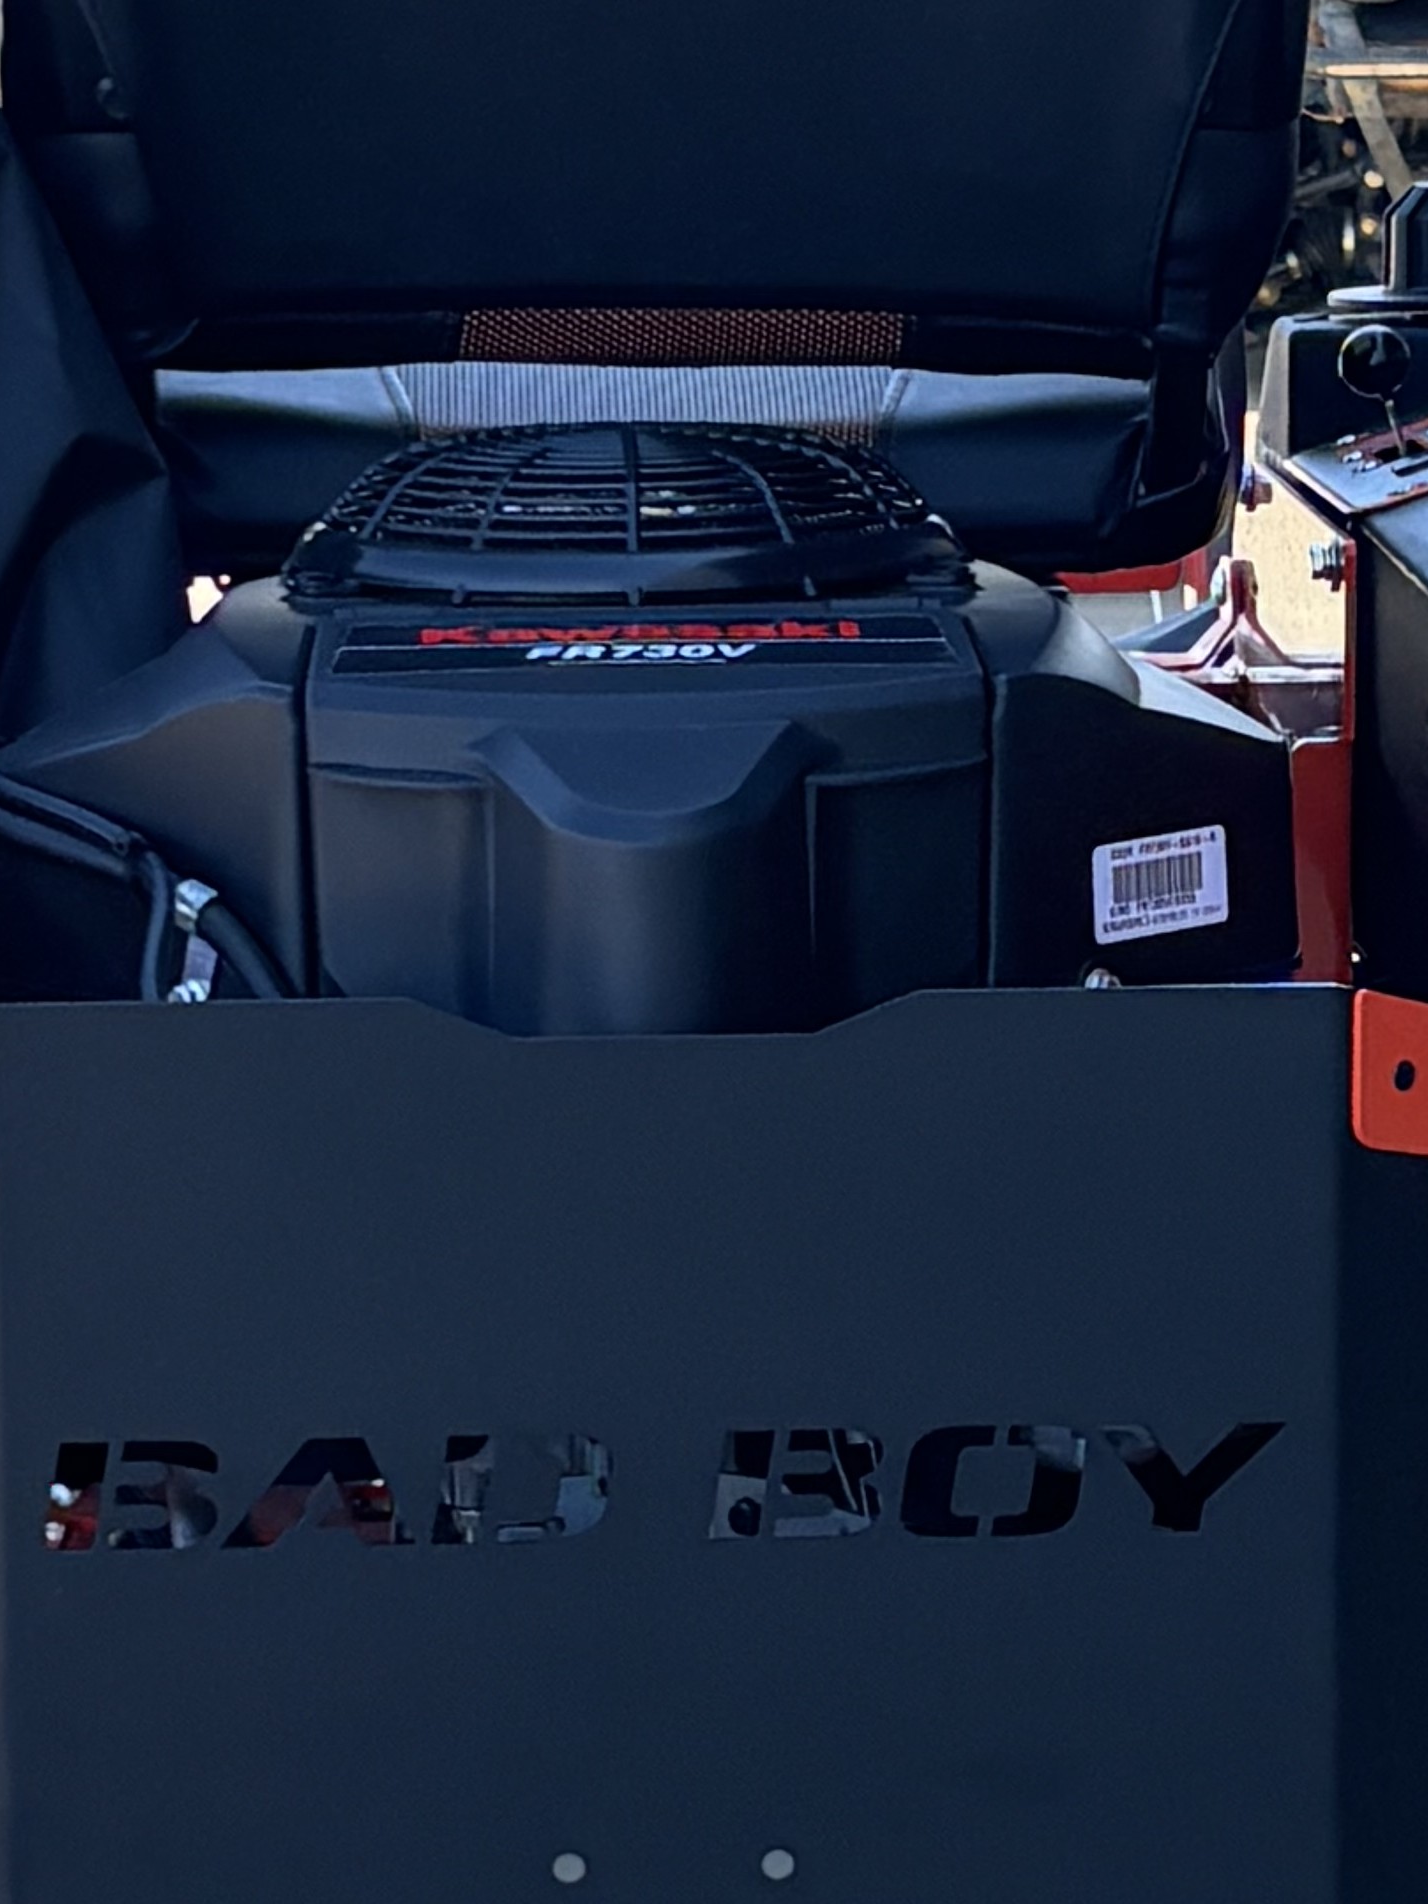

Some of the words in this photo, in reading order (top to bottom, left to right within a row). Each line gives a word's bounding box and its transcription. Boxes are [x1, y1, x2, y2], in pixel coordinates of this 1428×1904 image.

[525, 643, 758, 661] FR730V
[43, 1433, 614, 1551] BAD
[707, 1420, 1288, 1541] BOY
